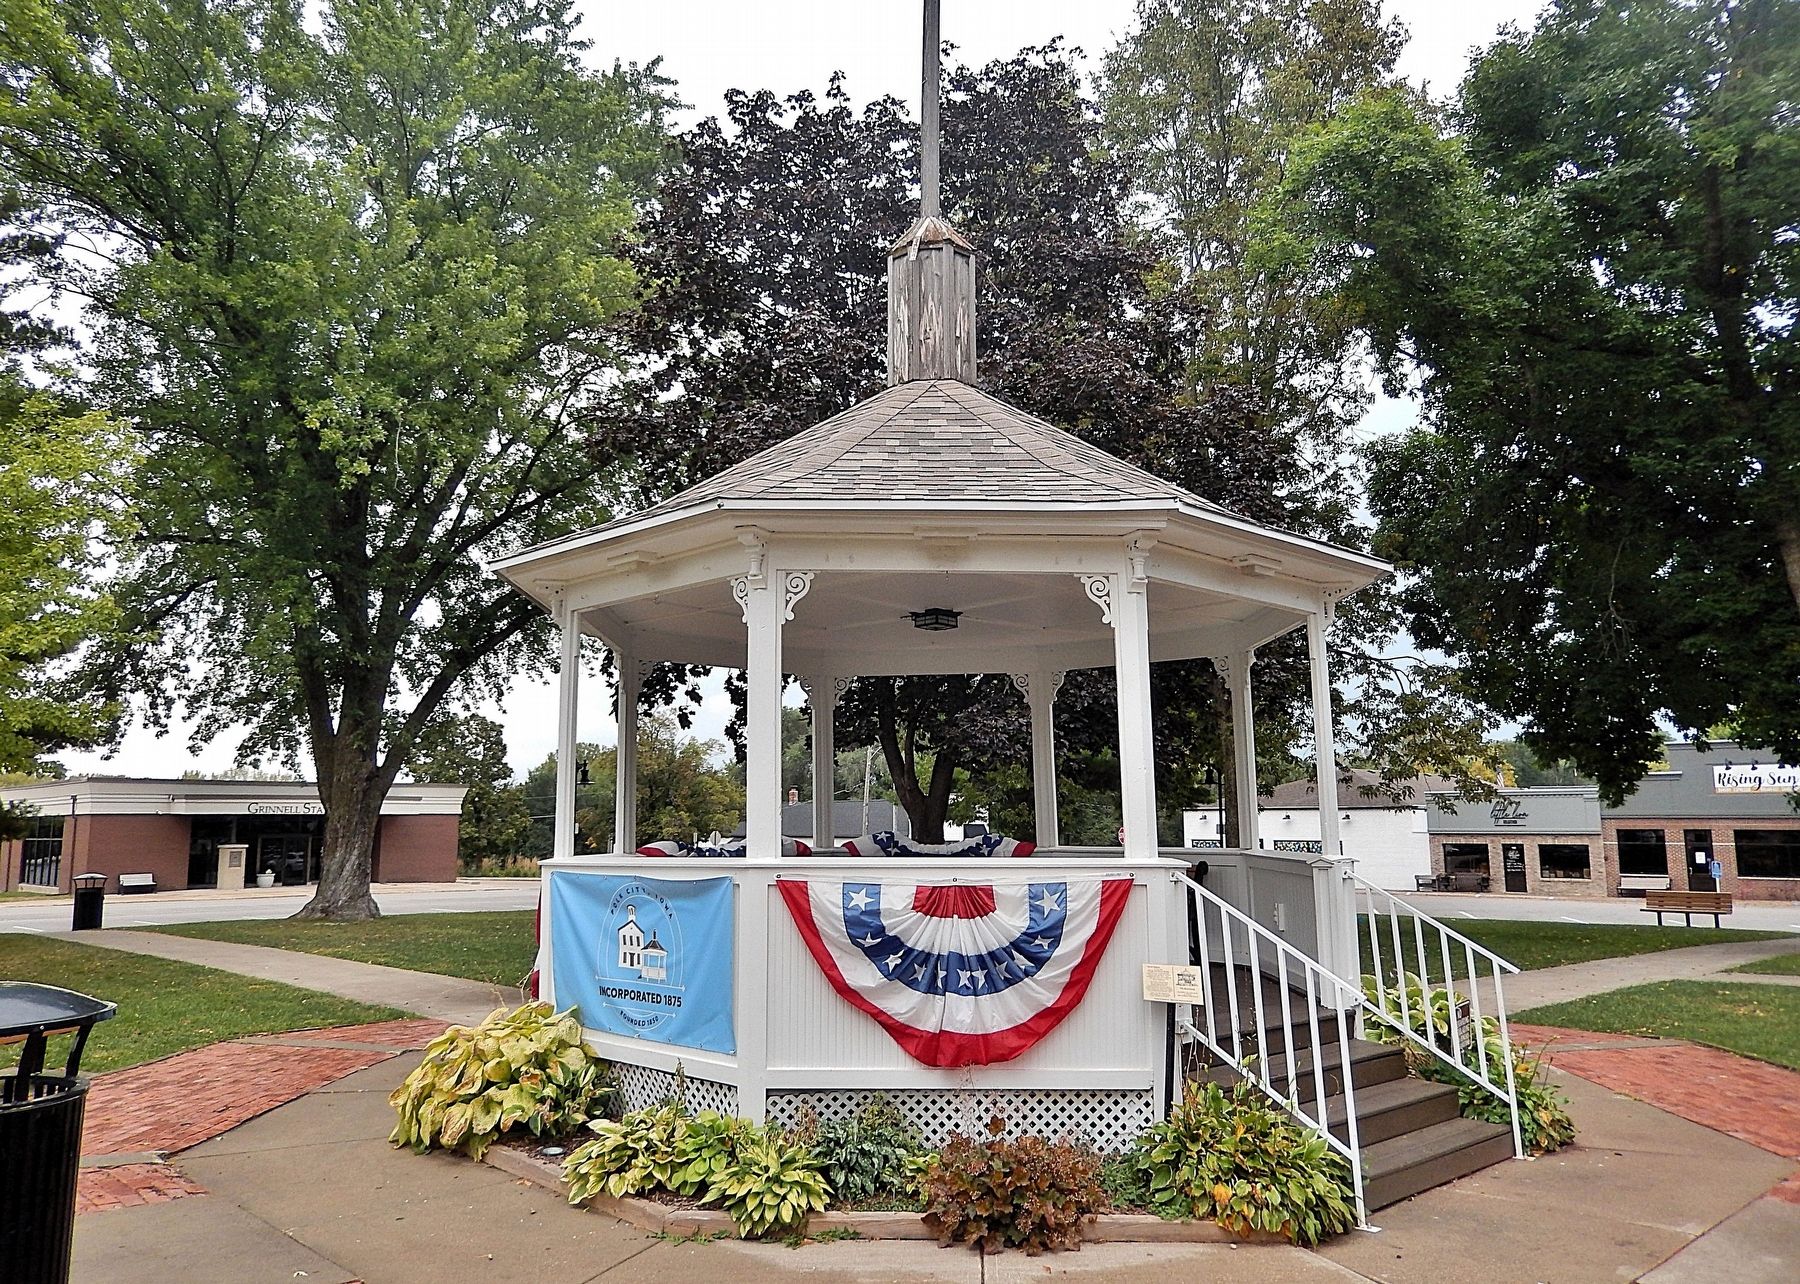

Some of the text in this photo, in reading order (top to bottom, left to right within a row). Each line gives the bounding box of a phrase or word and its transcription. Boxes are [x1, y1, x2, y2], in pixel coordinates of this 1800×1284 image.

[1718, 772, 1799, 791] Rising Sun
[247, 802, 323, 814] GRINNELL STA
[610, 893, 623, 915] POLK
[655, 894, 673, 919] IOWA
[599, 986, 682, 1008] INCORPORATED 1875
[620, 1010, 646, 1027] FOUNDED
